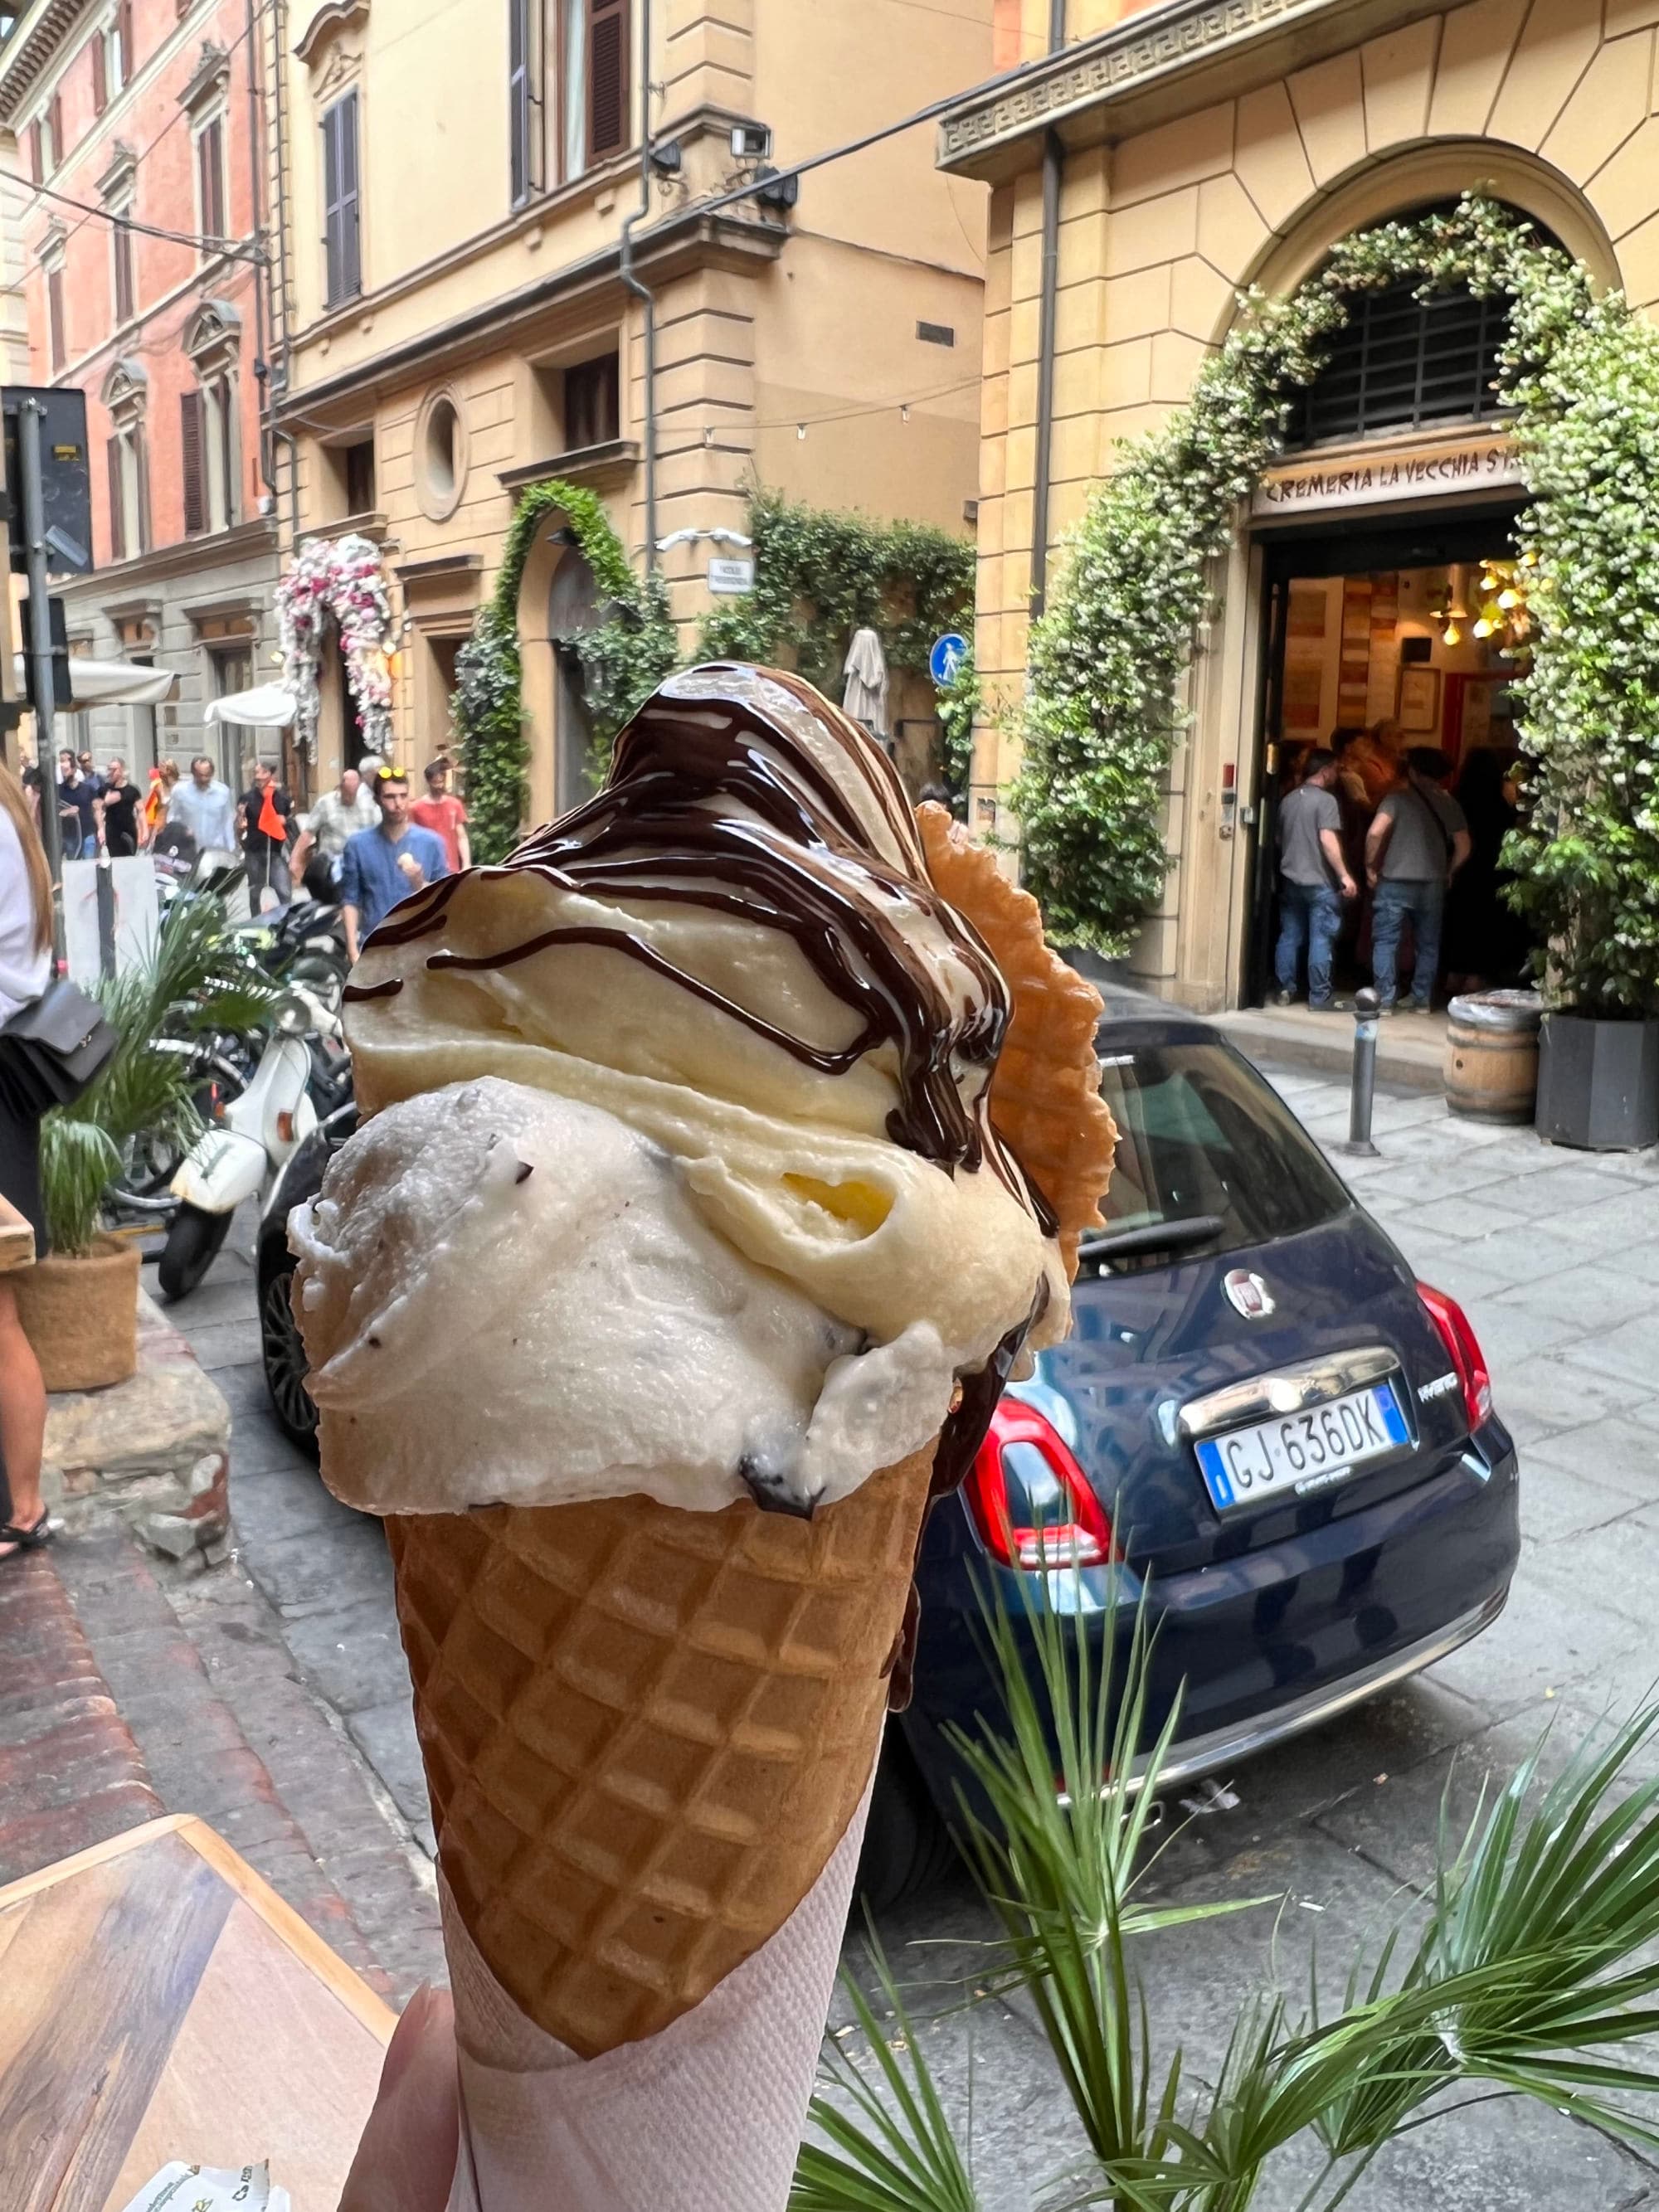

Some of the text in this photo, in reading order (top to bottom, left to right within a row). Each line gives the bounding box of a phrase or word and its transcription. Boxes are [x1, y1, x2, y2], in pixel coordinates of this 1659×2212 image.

[1266, 469, 1372, 502] CREMERIA
[1379, 462, 1400, 486] LA
[1405, 451, 1479, 481] VECCHIA
